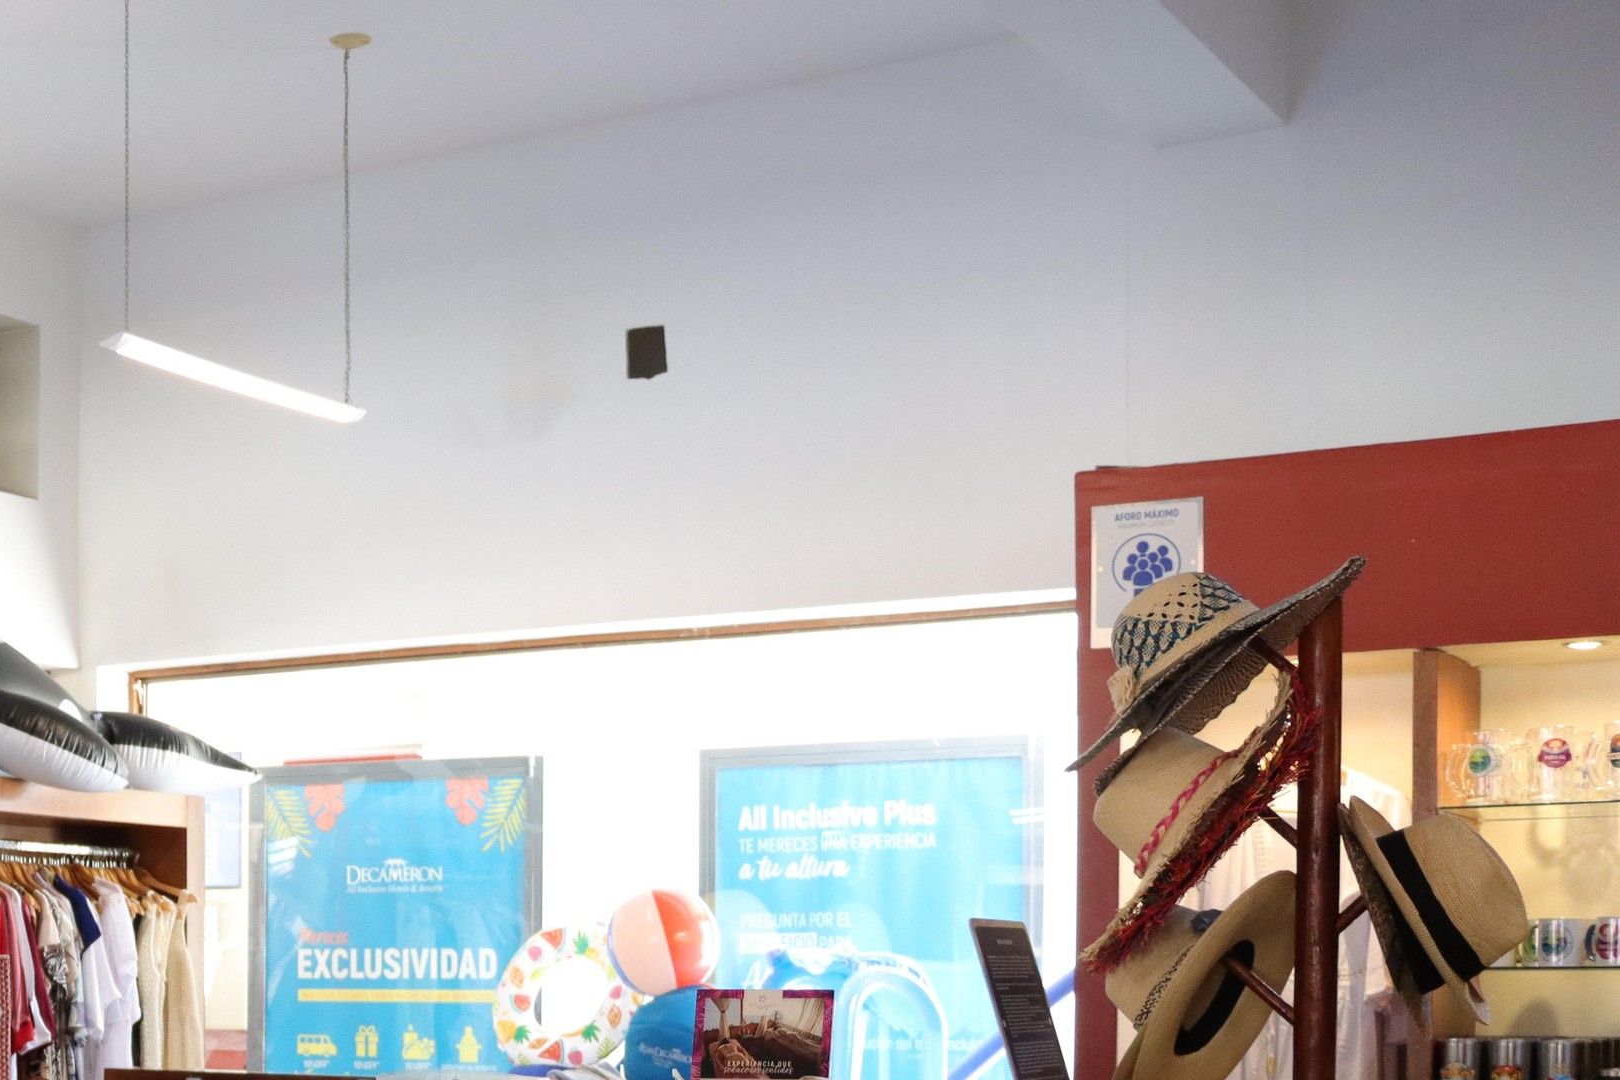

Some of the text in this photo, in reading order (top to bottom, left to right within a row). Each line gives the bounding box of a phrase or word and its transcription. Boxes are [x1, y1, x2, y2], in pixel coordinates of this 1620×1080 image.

[1115, 512, 1141, 521] AFORO
[739, 799, 937, 831] All Inclusive Plus
[739, 838, 753, 853] TE
[757, 836, 818, 852] MERECES
[851, 832, 937, 849] EXPERIENCIA
[346, 863, 443, 884] DECAMERON
[739, 853, 850, 881] a tu altura
[740, 911, 853, 928] PREGUNTA POR EL
[297, 948, 498, 980] EXCLUSIVIDAD
[776, 1060, 792, 1068] QUE
